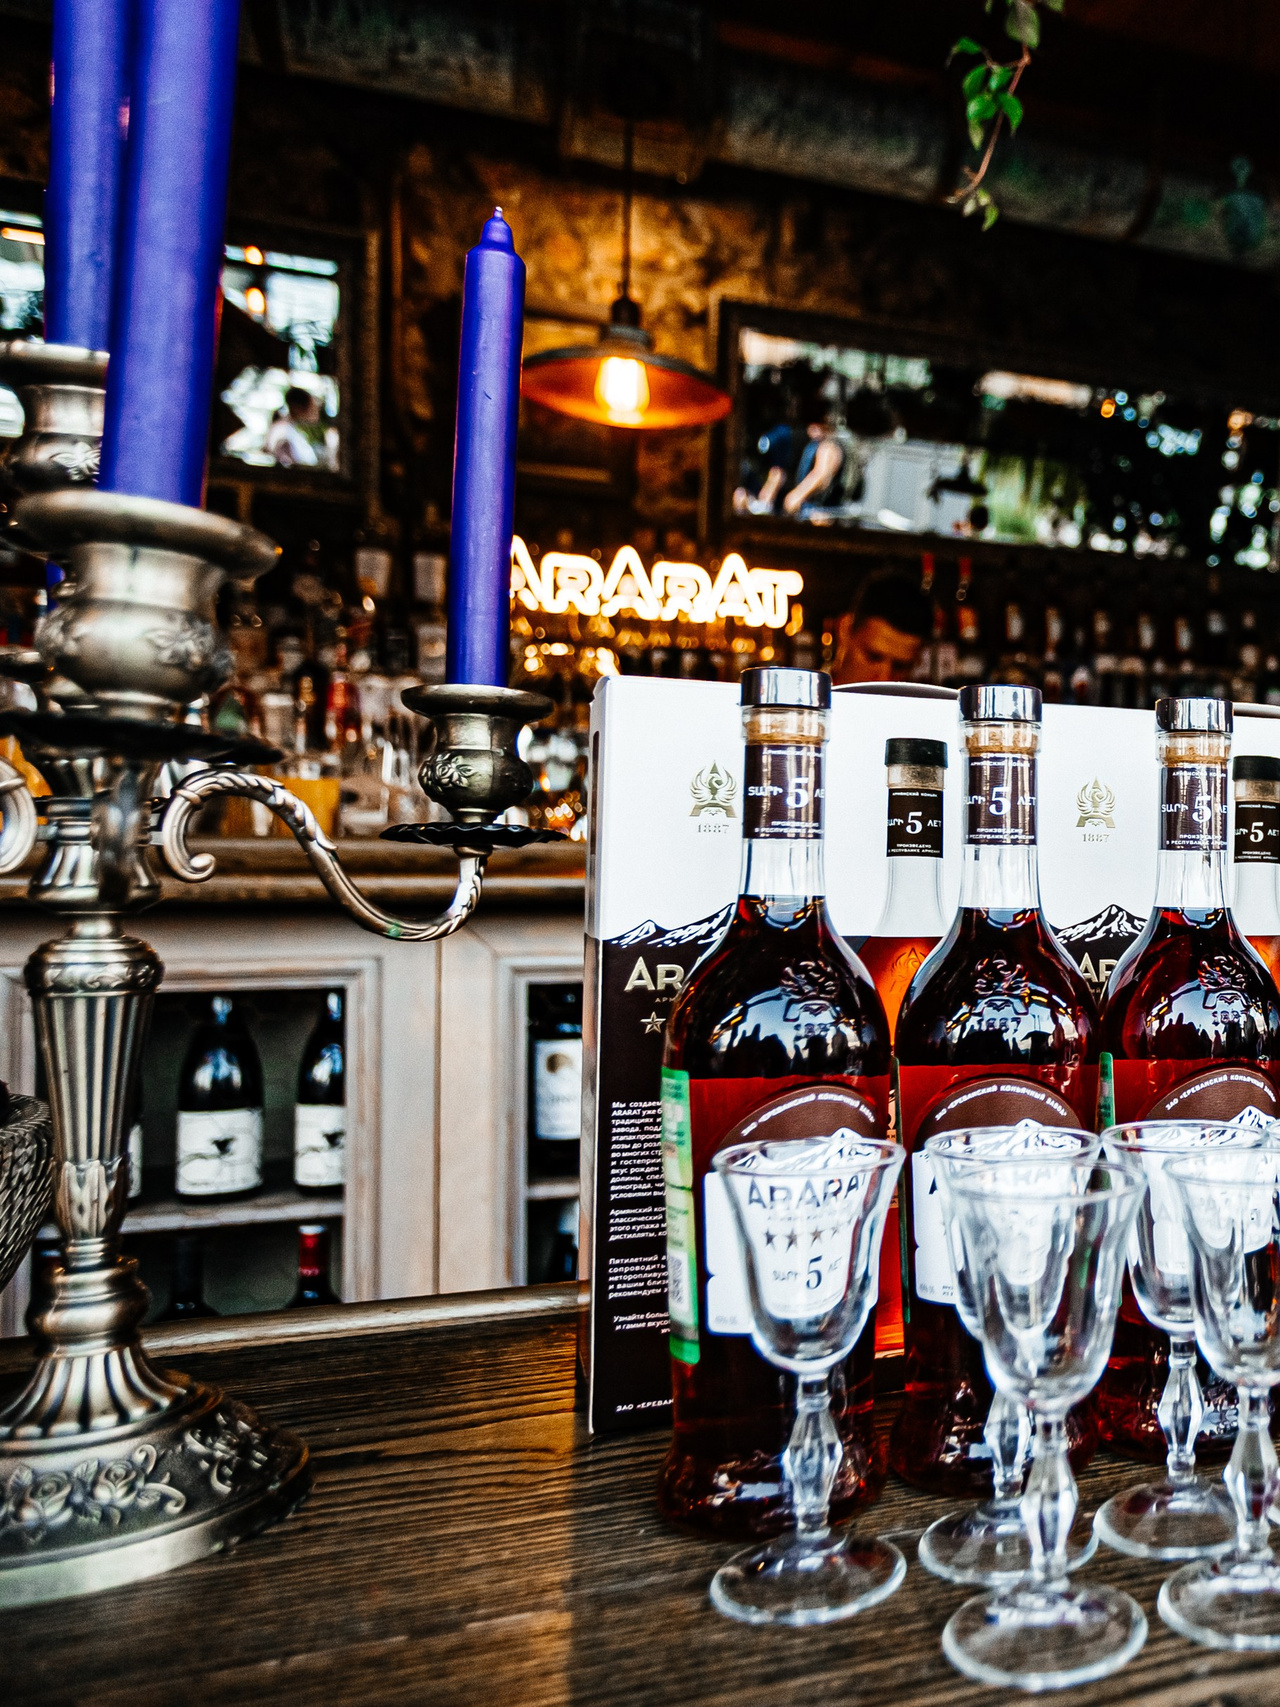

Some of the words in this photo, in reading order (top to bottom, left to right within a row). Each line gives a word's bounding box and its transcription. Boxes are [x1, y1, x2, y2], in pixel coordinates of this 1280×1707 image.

[786, 777, 809, 808] 5
[989, 787, 1011, 815] 5
[1017, 796, 1036, 806] ЛЕТ
[1192, 794, 1211, 822] 5
[906, 811, 922, 834] 5
[1082, 833, 1110, 843] 1887
[1250, 821, 1264, 843] 5
[624, 956, 685, 992] AR
[1165, 1098, 1179, 1110] ЗАО
[609, 1206, 652, 1216] Армянский
[609, 1255, 659, 1265] Пятилетний
[609, 1264, 666, 1273] сопроводить
[806, 1255, 823, 1290] 5
[609, 1288, 661, 1299] рекомендуем
[613, 1313, 644, 1323] Узнайте
[616, 1403, 634, 1412] ЗАО
